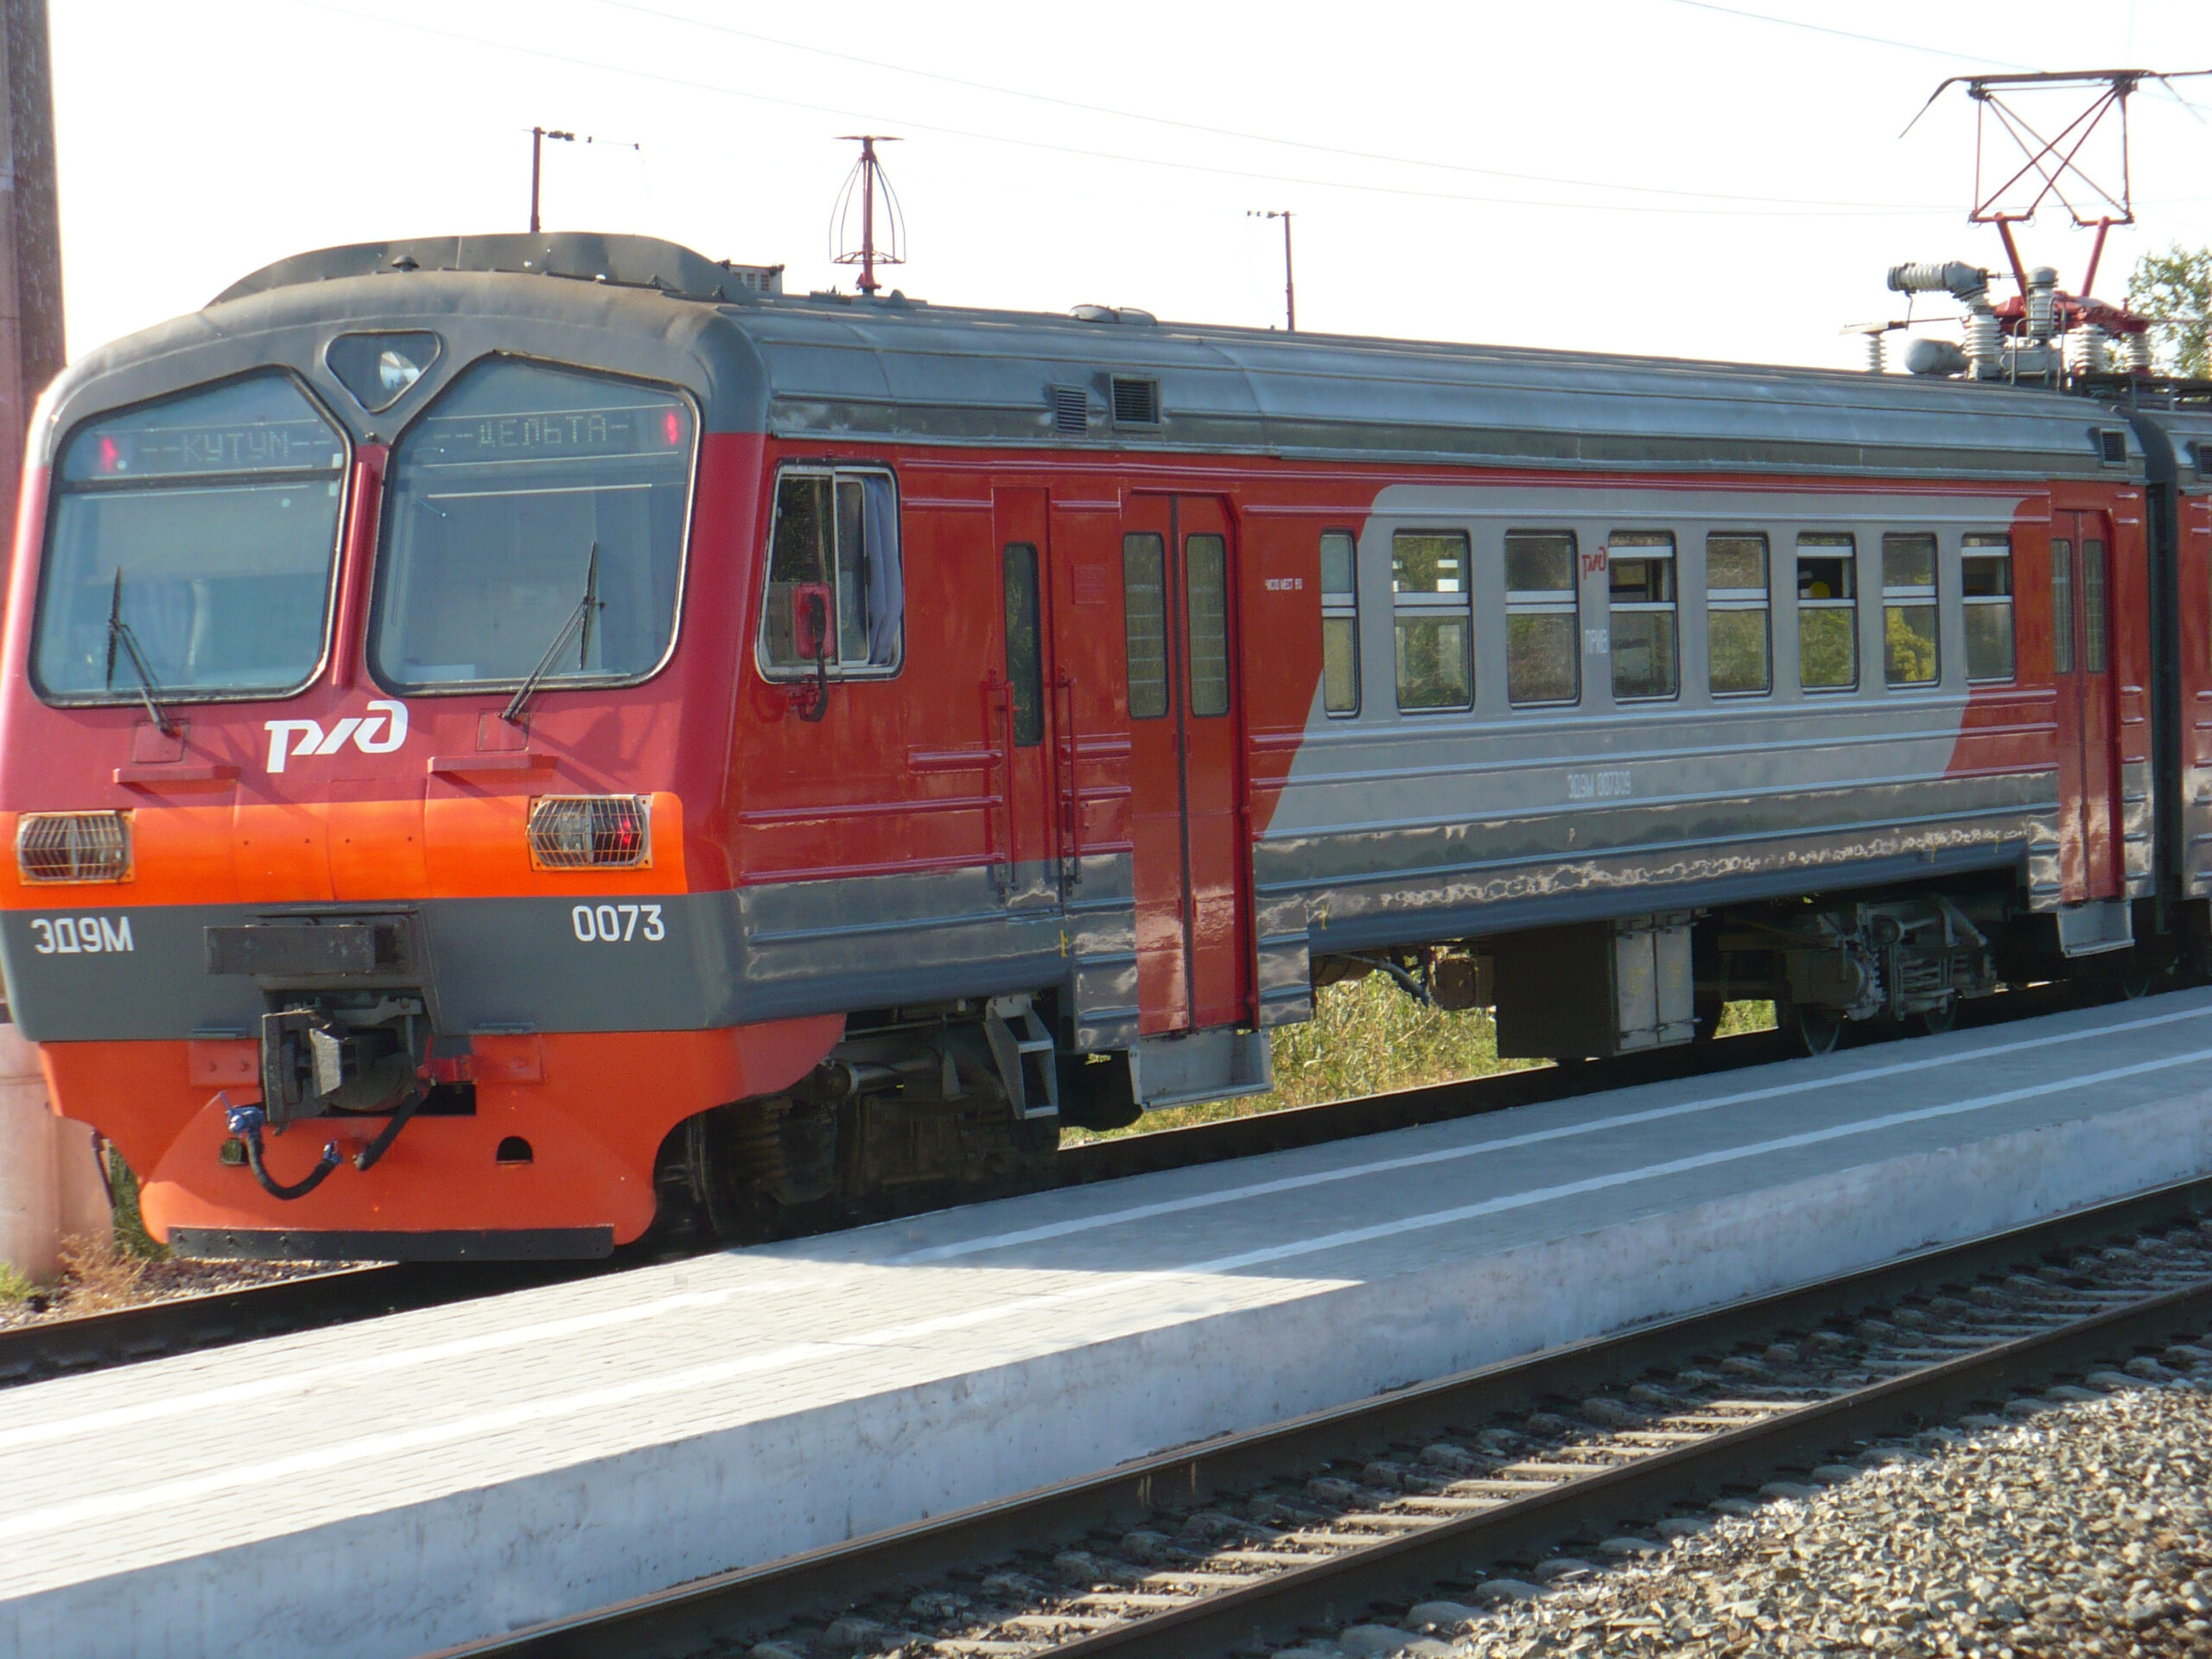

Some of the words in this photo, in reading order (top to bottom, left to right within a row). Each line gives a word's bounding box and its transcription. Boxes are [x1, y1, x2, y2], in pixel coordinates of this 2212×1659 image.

[264, 699, 409, 773] РЖД
[1567, 773, 1595, 799] ЭД9М
[30, 916, 135, 954] ЭД9М
[571, 904, 666, 942] 0073
